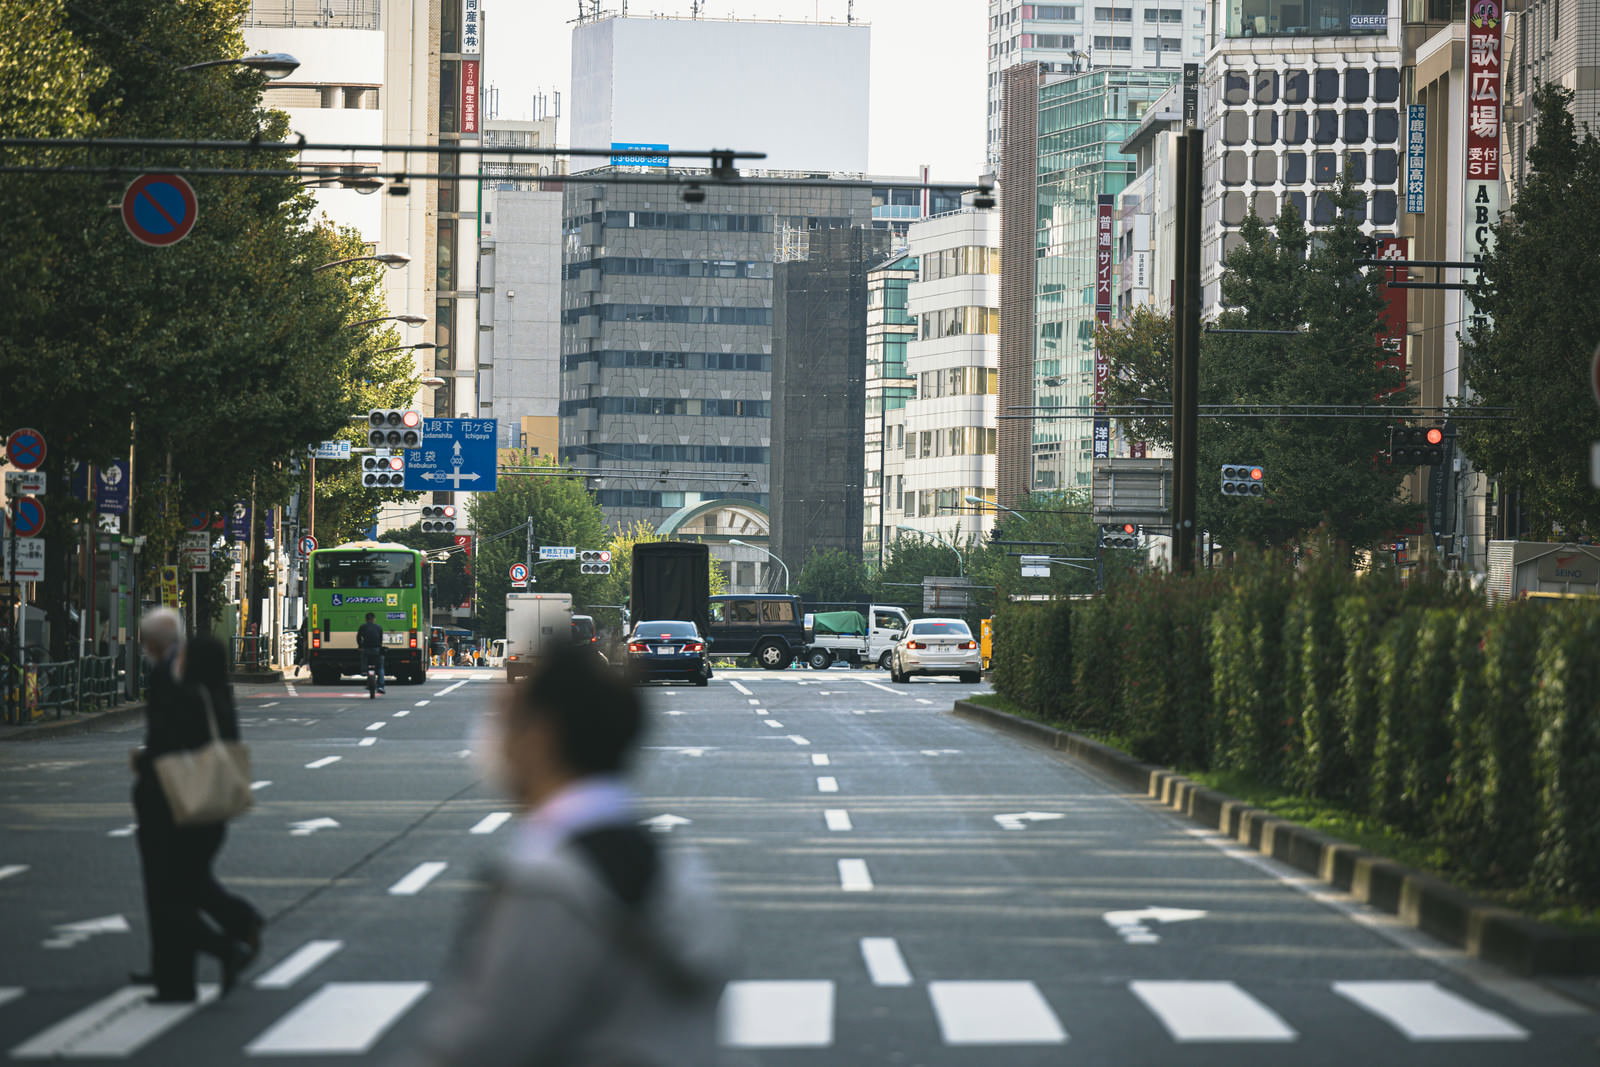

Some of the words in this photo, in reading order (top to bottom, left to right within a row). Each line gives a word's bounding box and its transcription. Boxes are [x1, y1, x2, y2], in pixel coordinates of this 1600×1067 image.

[1470, 34, 1499, 138] 歌広場
[1469, 148, 1497, 161] 受付
[1469, 163, 1497, 175] 5F
[409, 451, 436, 461] 池袋
